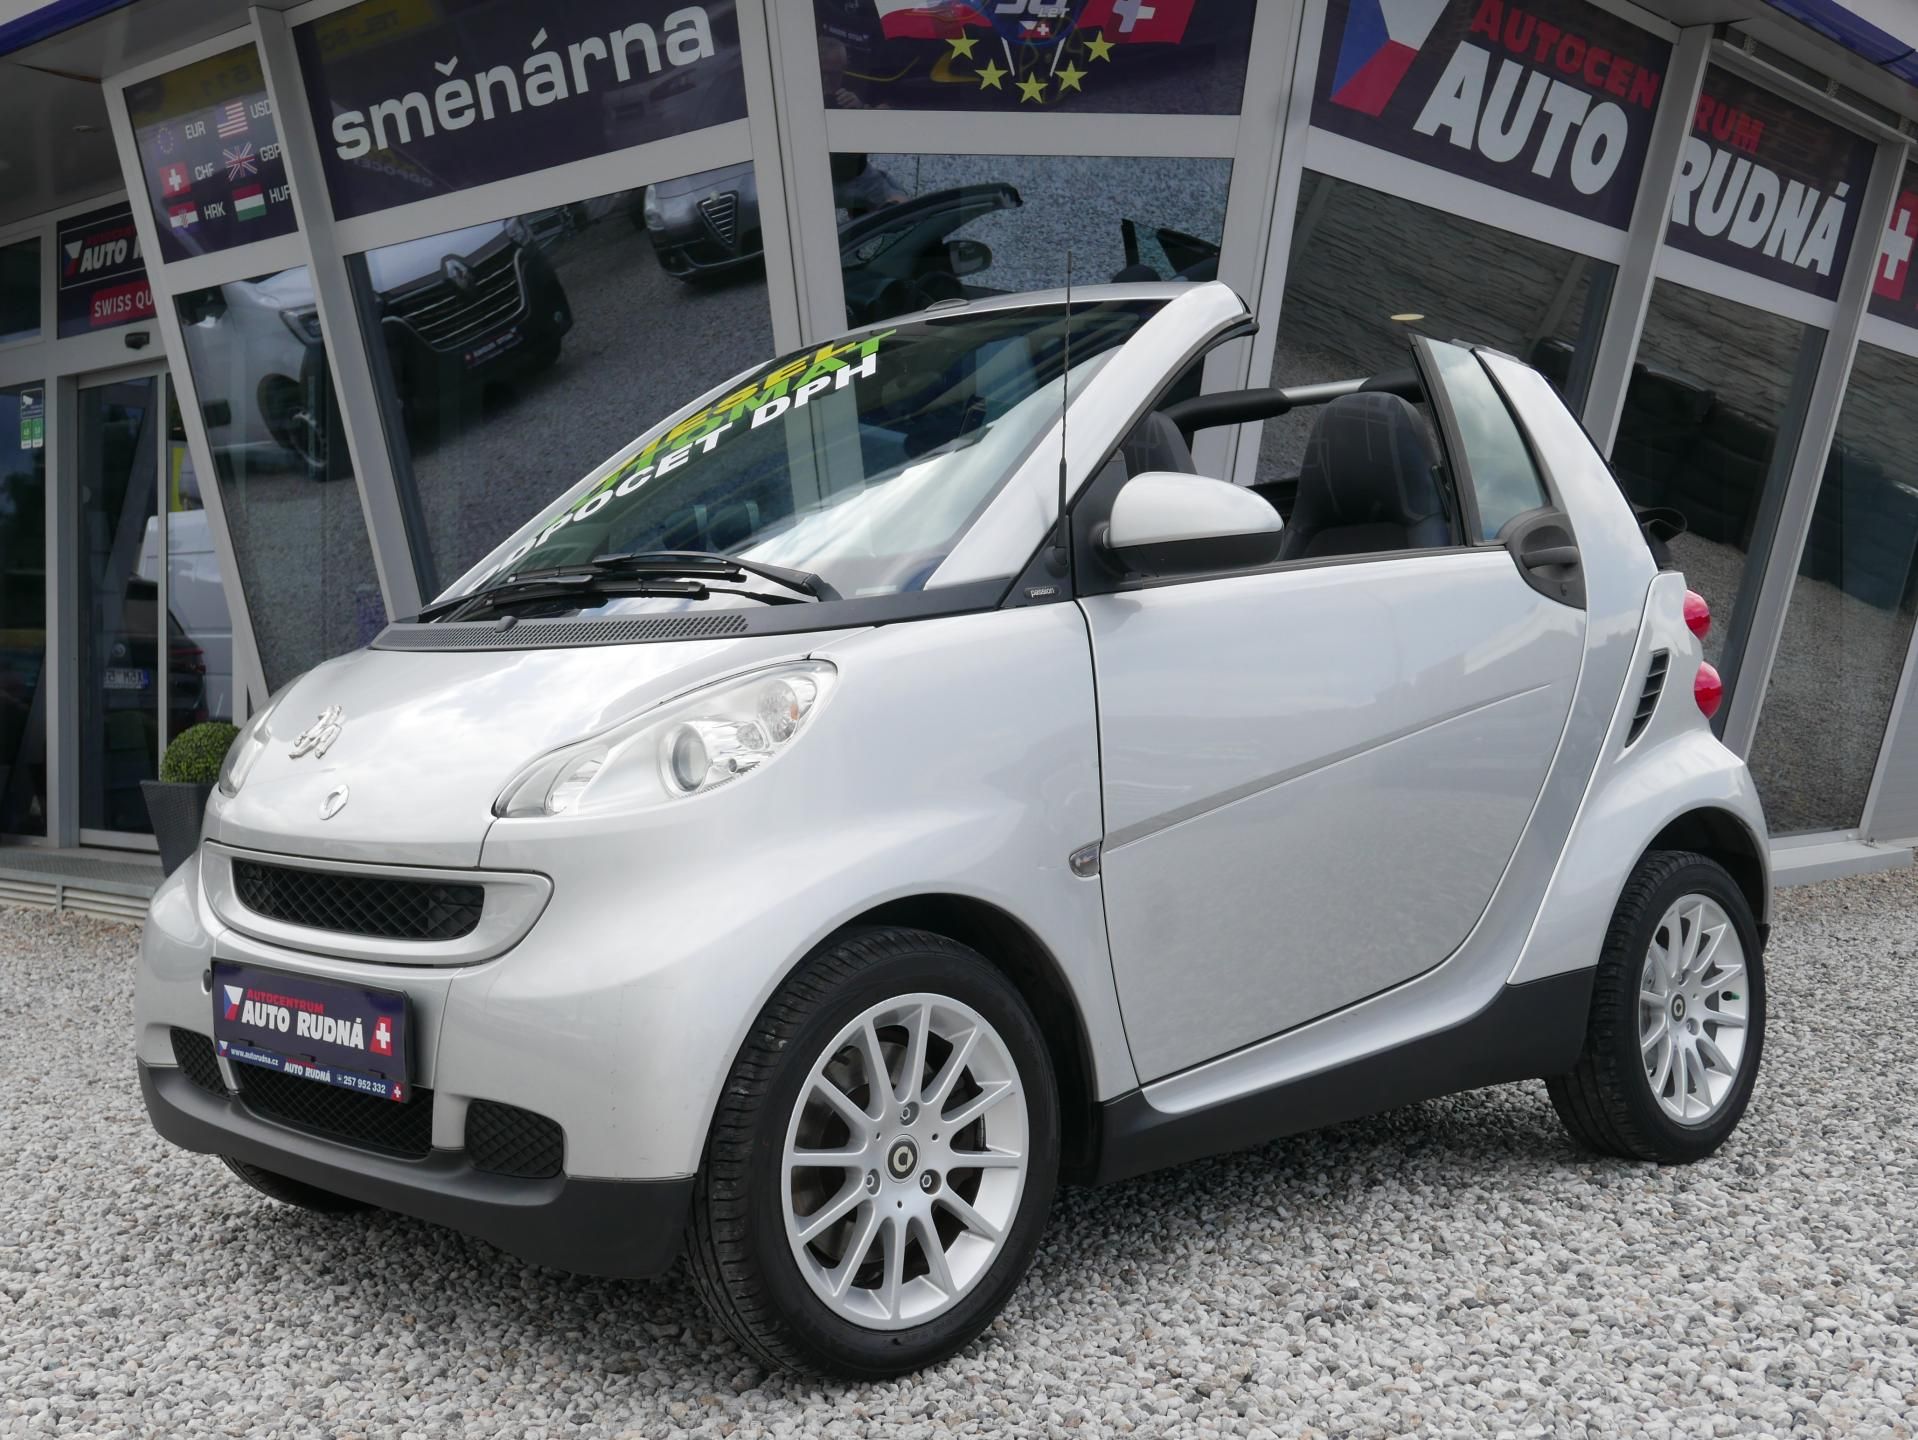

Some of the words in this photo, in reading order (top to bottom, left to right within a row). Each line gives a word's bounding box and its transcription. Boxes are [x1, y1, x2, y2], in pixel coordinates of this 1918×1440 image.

[332, 5, 714, 160] směnárna
[185, 121, 206, 139] EUR
[250, 99, 272, 118] USD
[194, 163, 215, 180] CHF
[259, 143, 282, 162] GBP
[1413, 40, 1628, 194] AUTO
[1672, 136, 1850, 276] RUDNÁ
[204, 201, 226, 219] HRK
[80, 239, 127, 273] AUTO
[94, 294, 131, 318] SWISS
[751, 352, 877, 429] DPH
[1030, 586, 1055, 598] passion
[247, 989, 326, 1014] AUTOCENTRUM
[241, 1000, 290, 1033] AUTO
[297, 1010, 364, 1050] RUDNÁ
[284, 1062, 303, 1076] AUTO
[305, 1067, 331, 1083] RUDNÁ
[343, 1075, 356, 1086] 257
[357, 1078, 371, 1089] 952
[372, 1082, 386, 1094] 332
